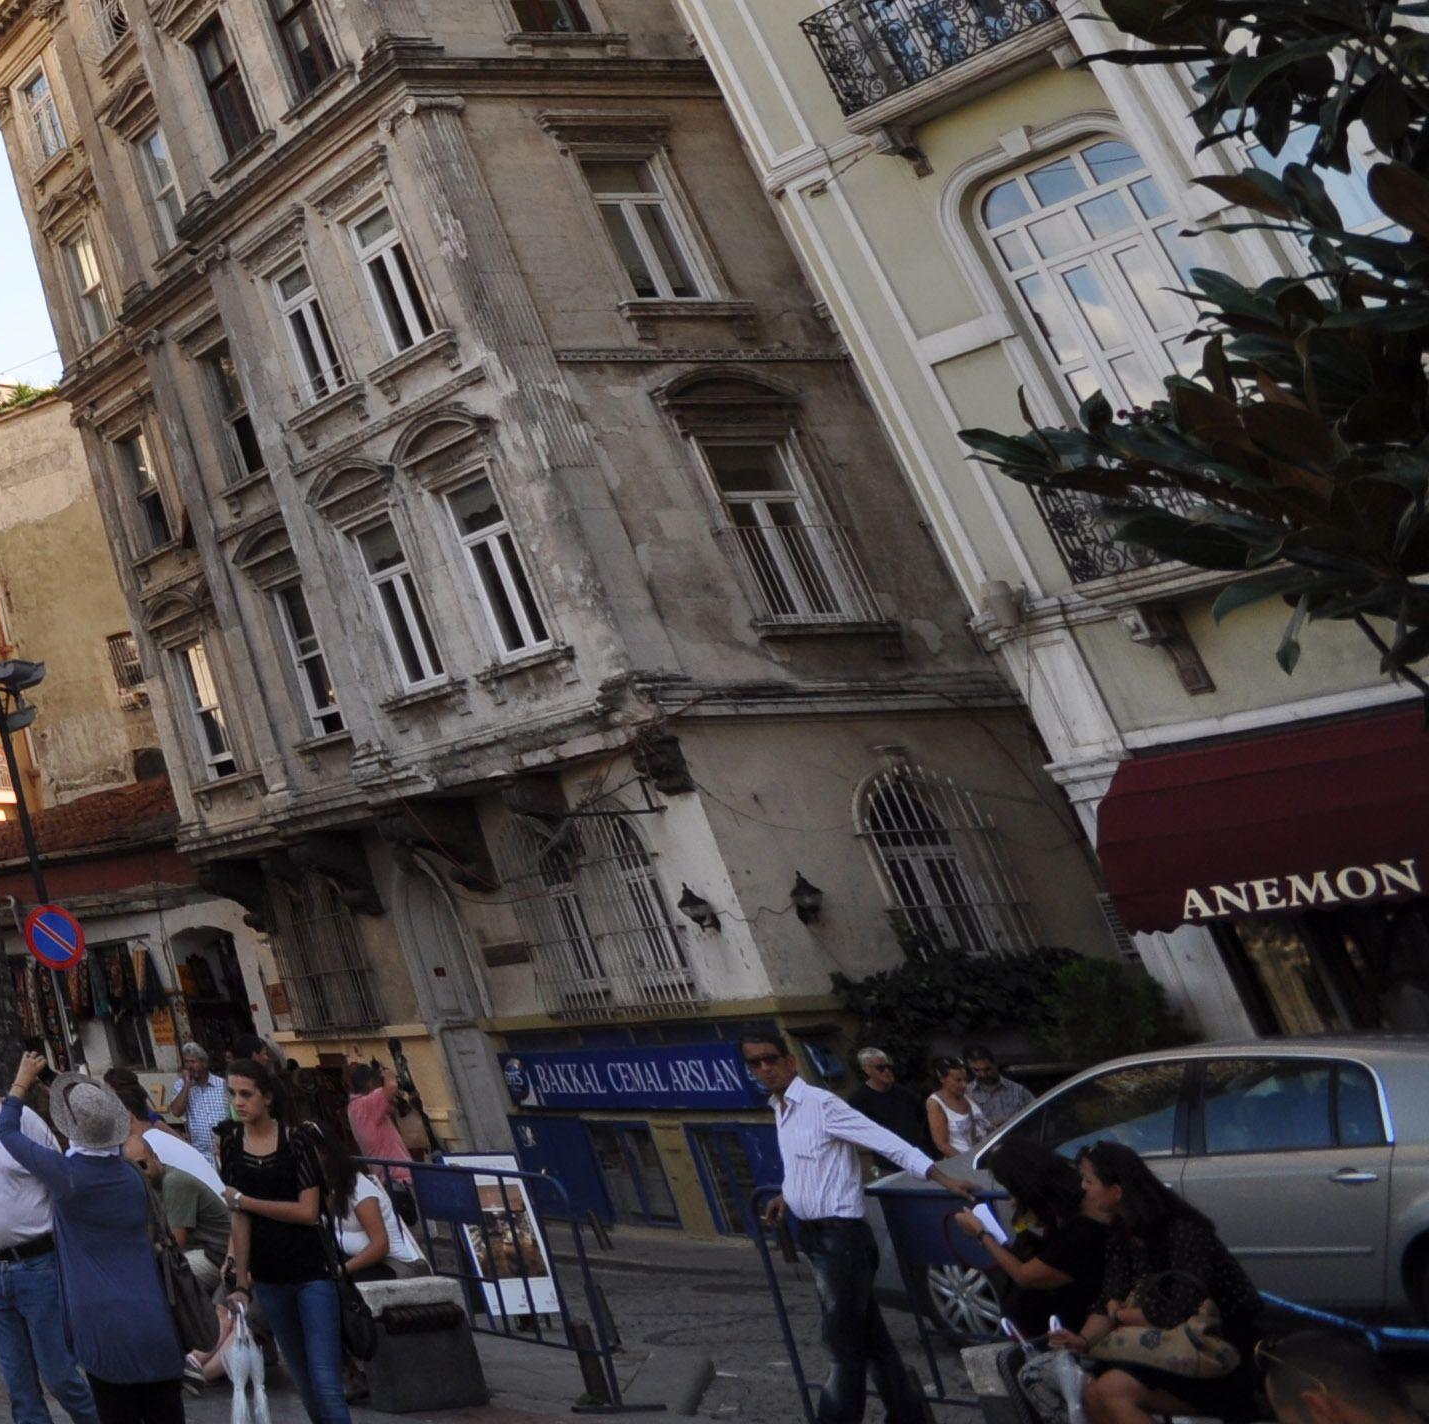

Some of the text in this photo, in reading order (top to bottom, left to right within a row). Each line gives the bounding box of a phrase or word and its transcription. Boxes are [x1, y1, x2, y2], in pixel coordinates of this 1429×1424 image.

[1183, 859, 1422, 920] ANEMON
[534, 1062, 608, 1095] BAKKAL
[607, 1060, 669, 1094] CEMAL
[669, 1059, 744, 1093] ARSLAN
